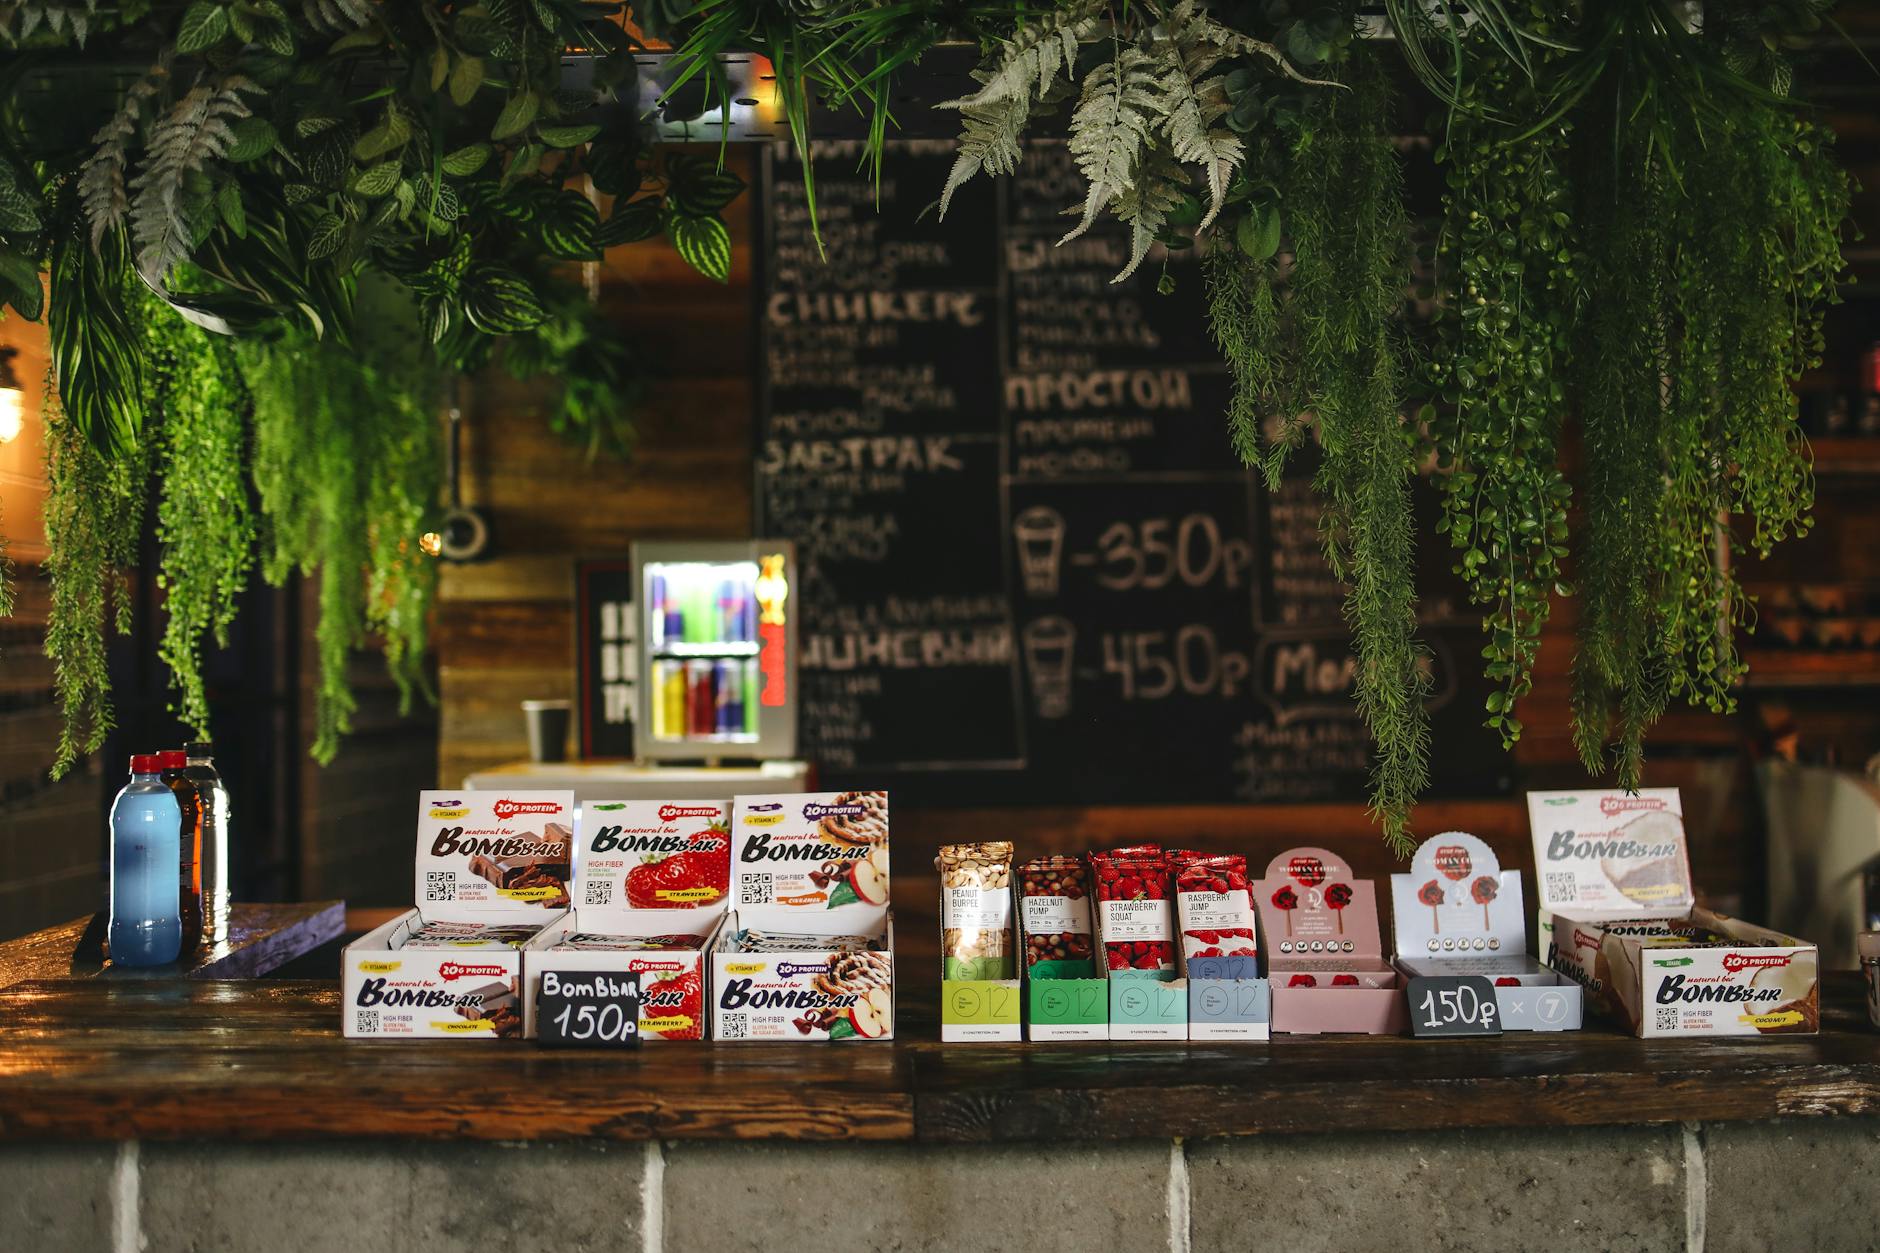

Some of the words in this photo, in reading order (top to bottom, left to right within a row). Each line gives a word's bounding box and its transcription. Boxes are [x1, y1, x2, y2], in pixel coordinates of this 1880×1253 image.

[497, 804, 519, 812] 20G
[661, 808, 681, 816] 20G
[806, 806, 826, 816] 20G
[1188, 894, 1231, 902] RASPBERRY
[953, 899, 978, 907] BURPEE
[1110, 903, 1157, 911] STRAWBERRY
[1111, 913, 1132, 921] SQUAT
[1726, 958, 1747, 966] 20G
[443, 966, 465, 975] 20G
